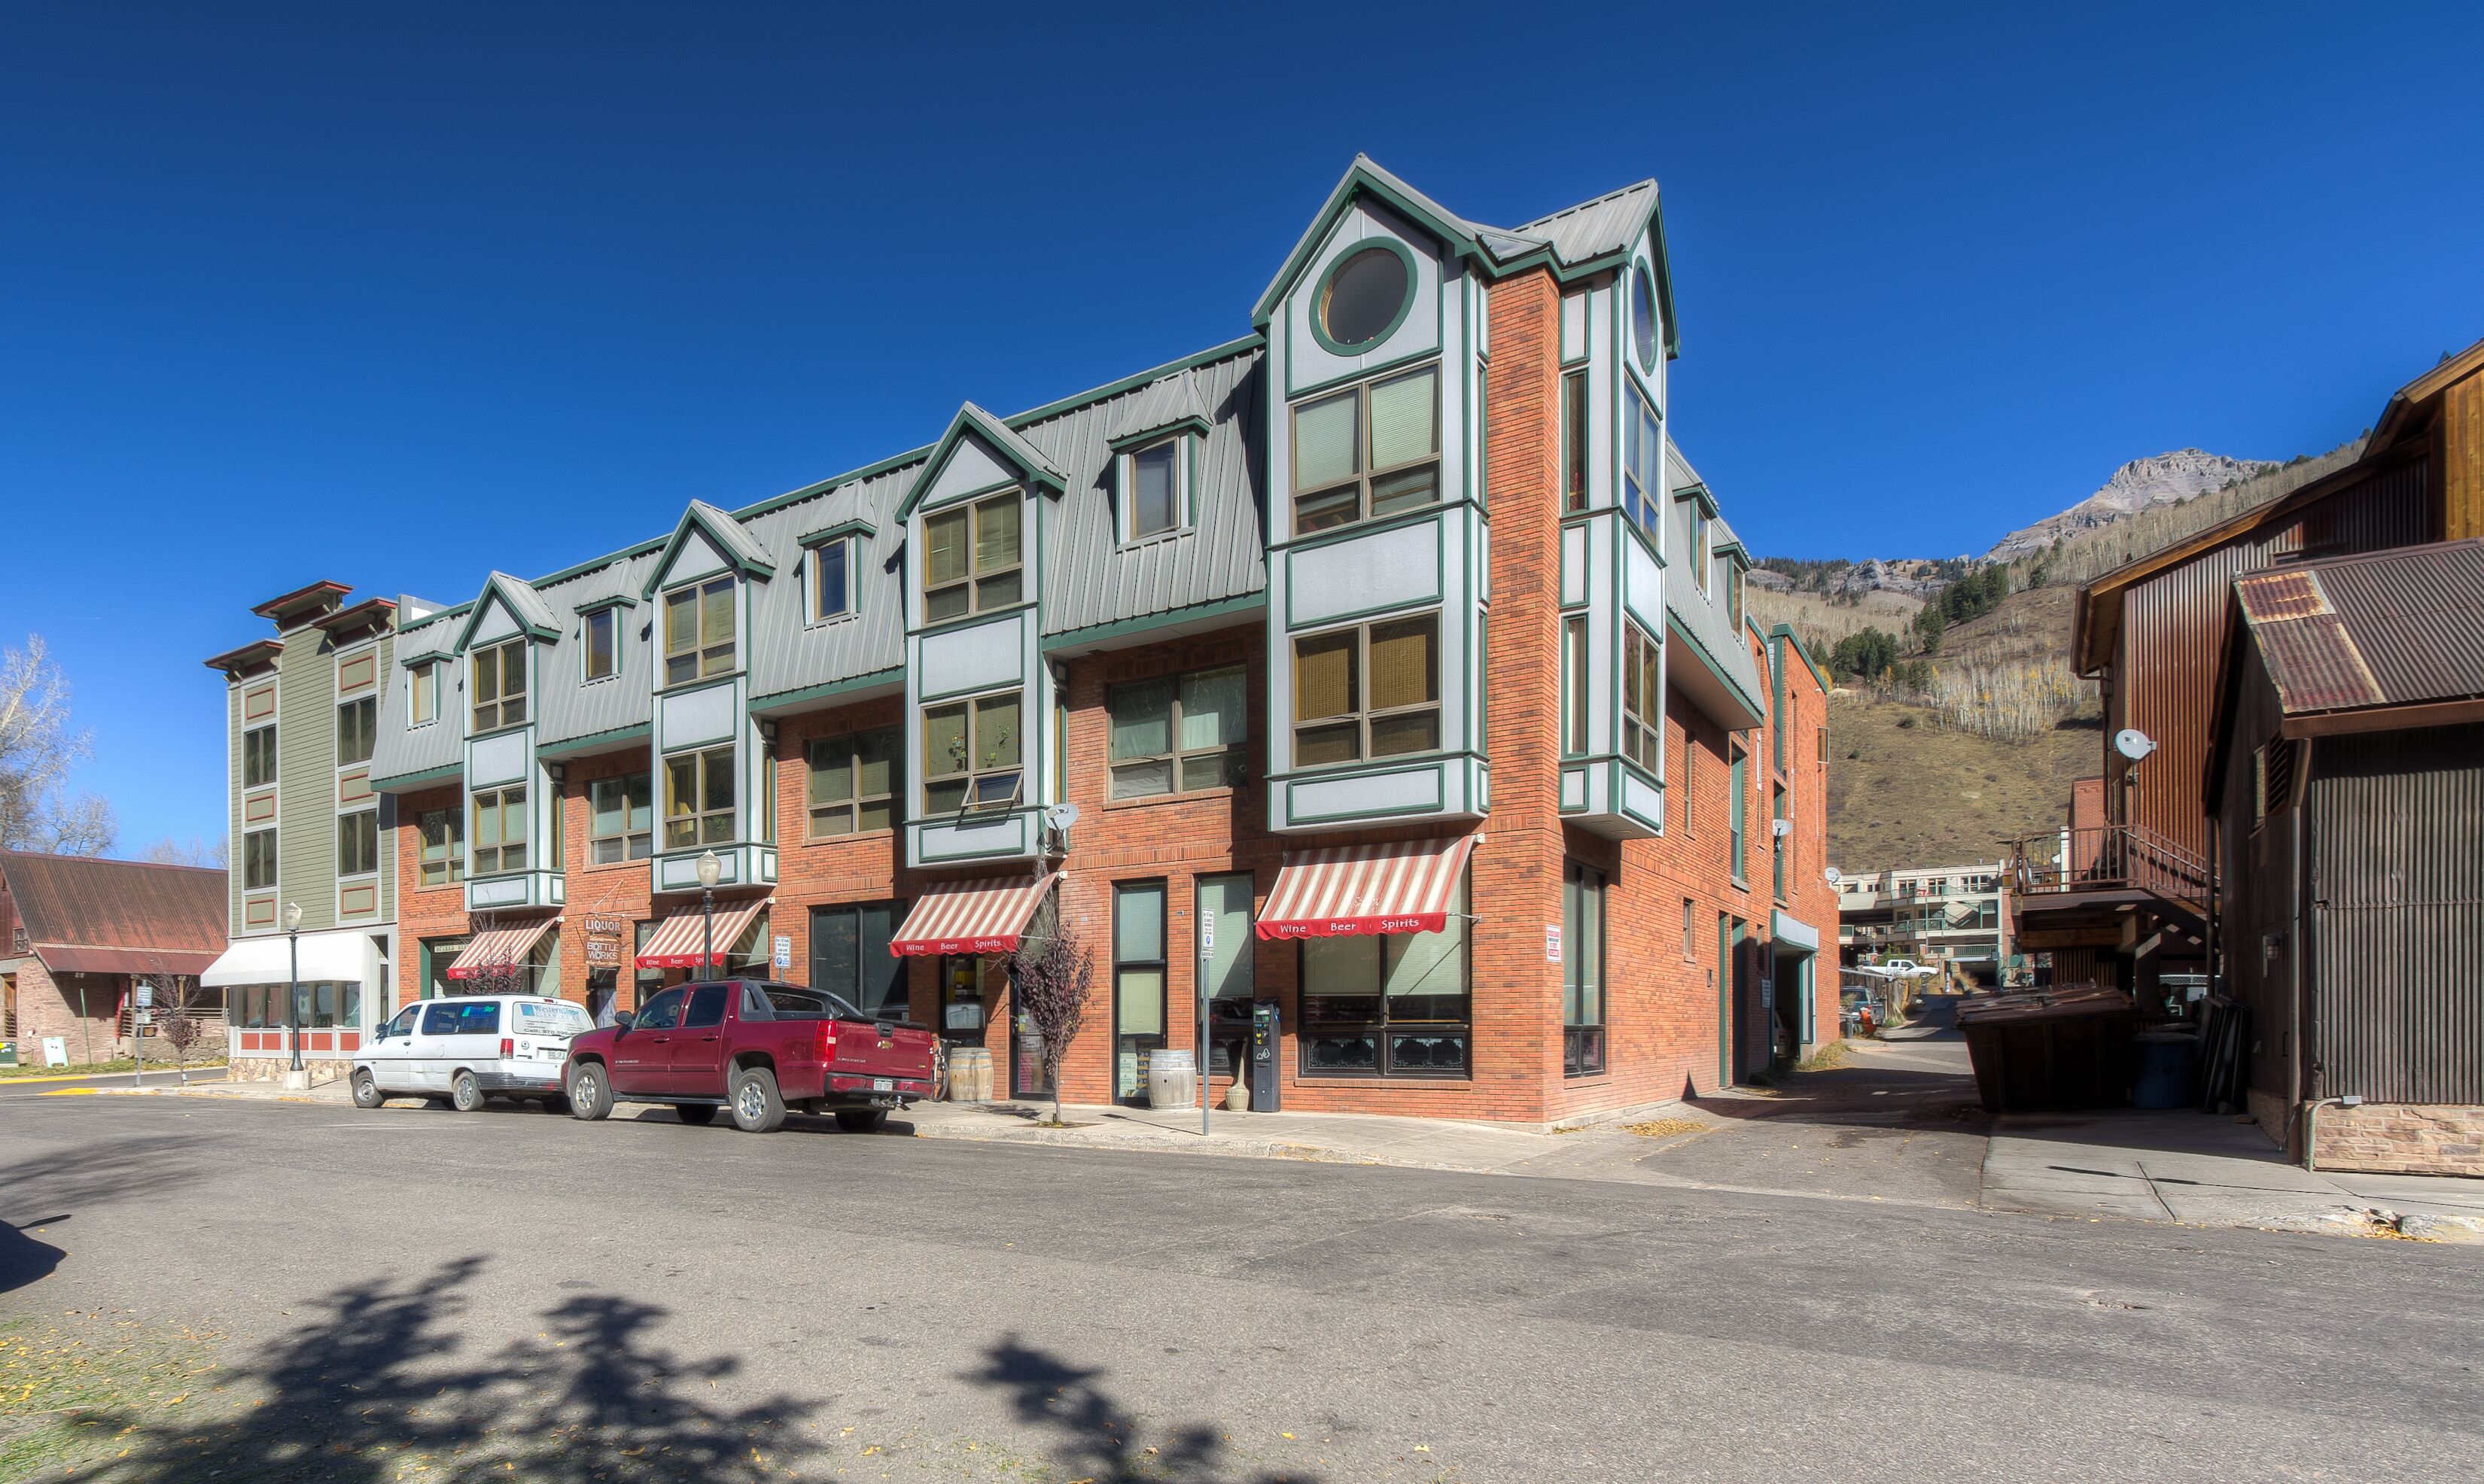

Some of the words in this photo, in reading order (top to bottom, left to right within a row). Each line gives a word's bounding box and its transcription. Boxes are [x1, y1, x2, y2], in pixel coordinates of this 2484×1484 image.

[585, 919, 621, 932] LIQUOR
[1280, 924, 1306, 933] Wine
[1330, 922, 1356, 931] Beer
[1381, 918, 1420, 929] Spirits
[587, 941, 619, 952] BOTTLE
[975, 939, 1001, 949] Spirits
[588, 950, 619, 960] WORKS
